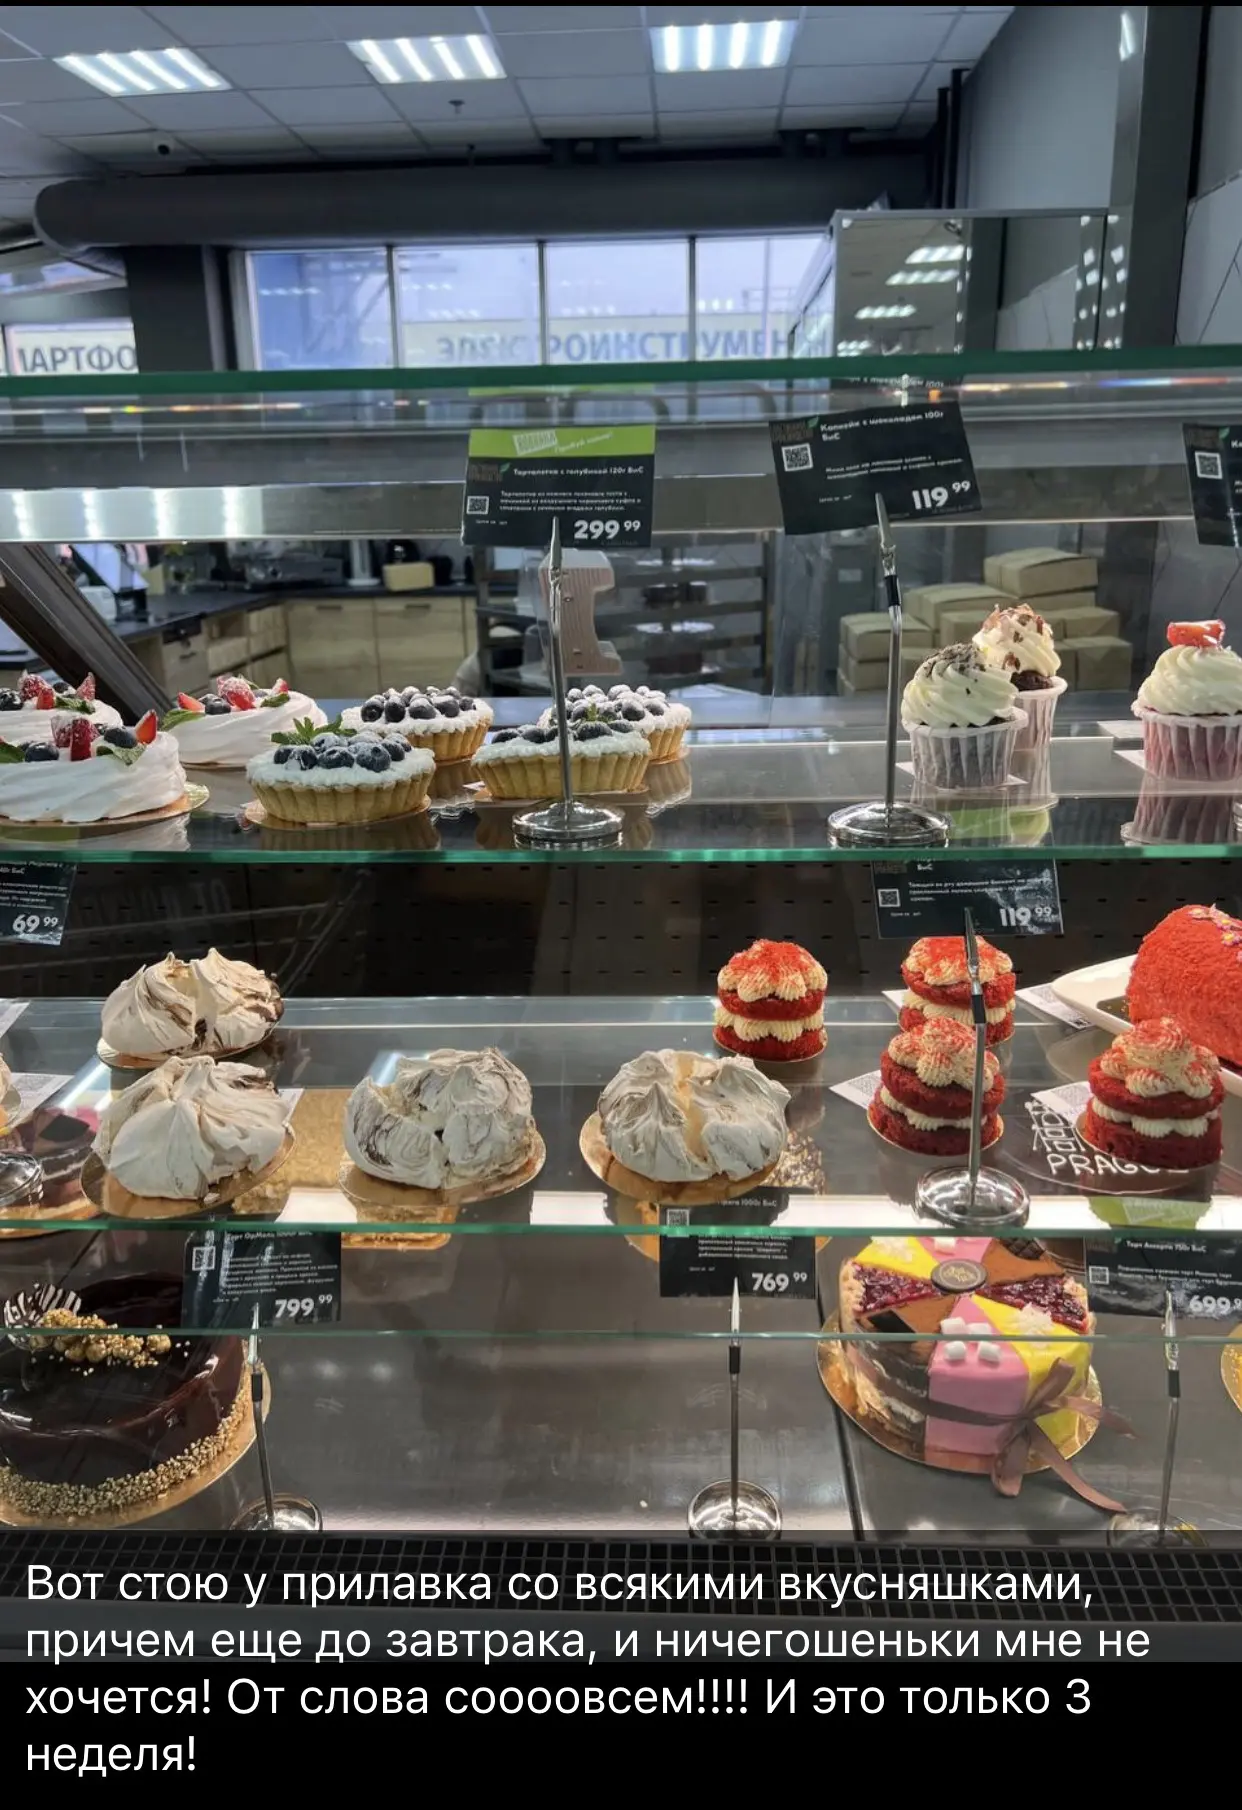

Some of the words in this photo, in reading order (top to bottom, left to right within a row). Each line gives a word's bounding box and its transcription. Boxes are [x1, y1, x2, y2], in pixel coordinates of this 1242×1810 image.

[912, 487, 949, 510] 119
[952, 480, 971, 493] 99
[574, 520, 620, 539] 299
[623, 520, 641, 532] 99
[12, 914, 40, 933] 69
[43, 916, 59, 928] 99
[1000, 907, 1031, 927] 119
[1034, 906, 1052, 918] 99
[1046, 1153, 1190, 1176] PRAG
[751, 1272, 789, 1292] 769
[793, 1272, 808, 1282] 99
[275, 1298, 315, 1318] 799
[318, 1294, 333, 1304] 99
[1189, 1295, 1231, 1316] 699
[1233, 1298, 1242, 1310] 9
